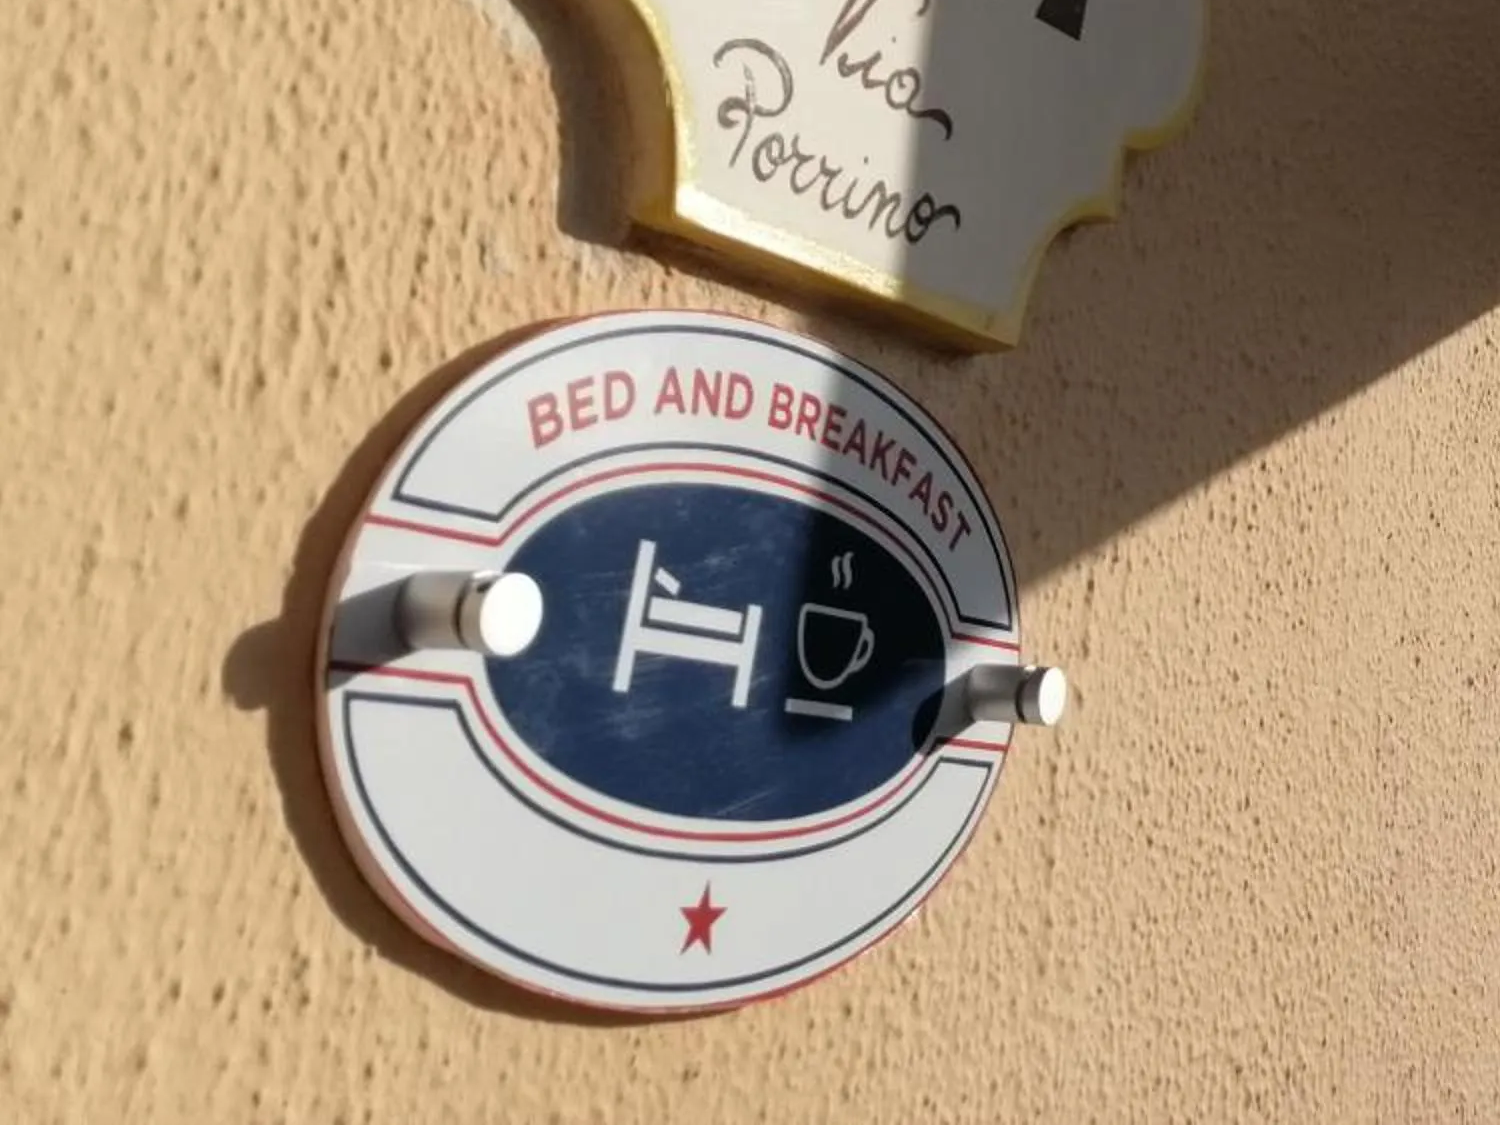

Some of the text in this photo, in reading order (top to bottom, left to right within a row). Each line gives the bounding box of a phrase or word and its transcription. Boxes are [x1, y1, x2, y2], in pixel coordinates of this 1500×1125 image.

[712, 37, 962, 245] Porrino
[526, 366, 972, 552] BED AND BREAKFAST
